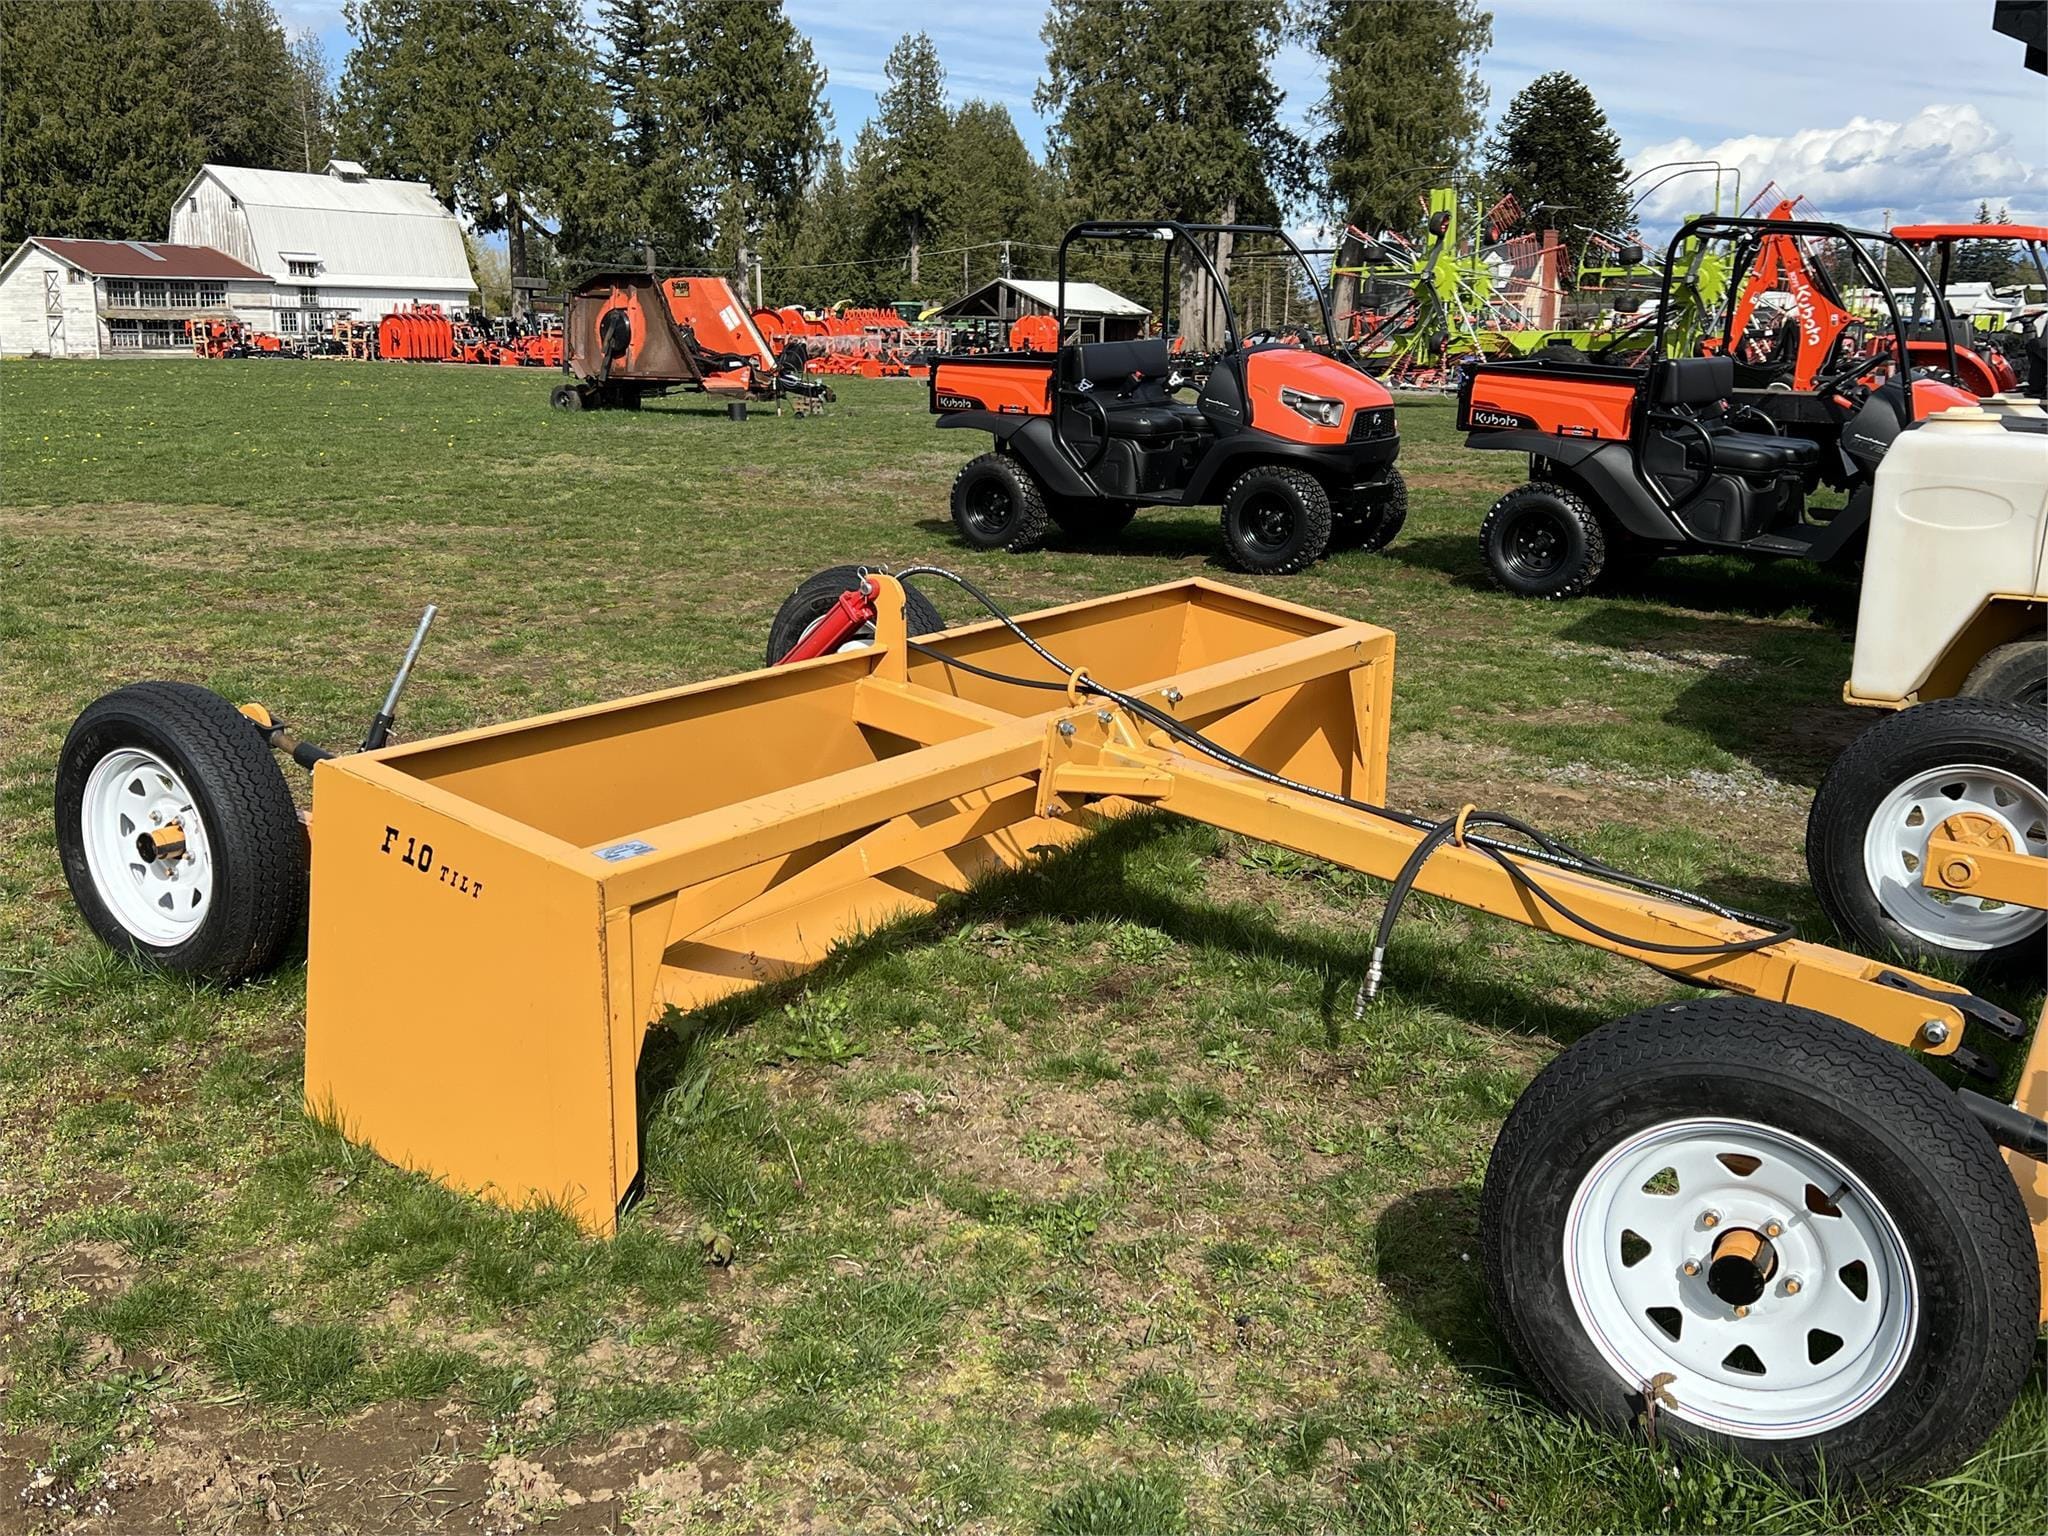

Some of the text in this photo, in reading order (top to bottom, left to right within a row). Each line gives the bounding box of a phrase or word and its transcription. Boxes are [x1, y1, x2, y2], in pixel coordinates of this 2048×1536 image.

[1796, 284, 1821, 346] Kubota
[940, 397, 972, 408] Kubota
[1475, 412, 1518, 427] Kubota
[380, 825, 483, 899] F 10 TILT
